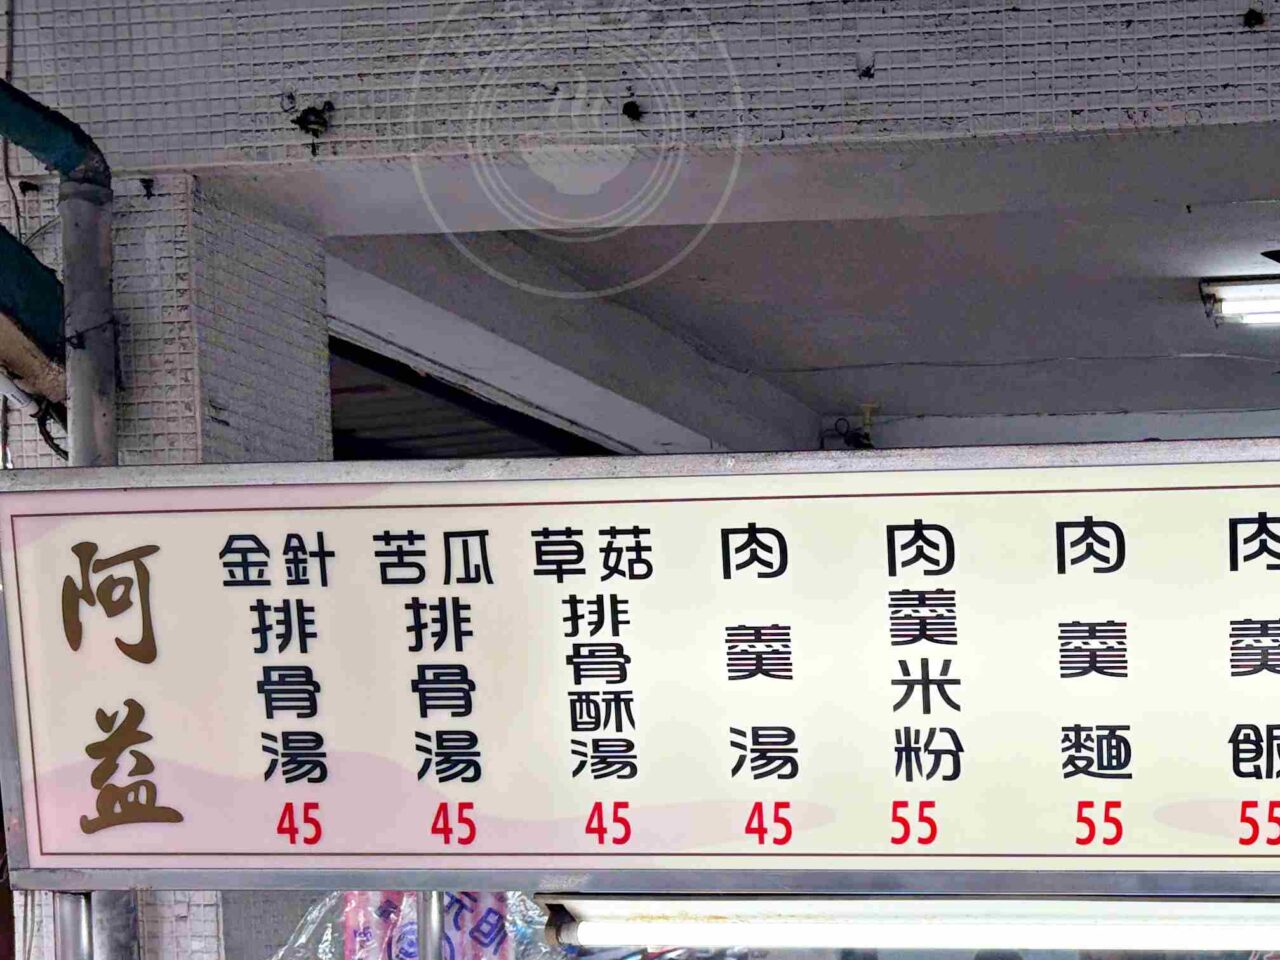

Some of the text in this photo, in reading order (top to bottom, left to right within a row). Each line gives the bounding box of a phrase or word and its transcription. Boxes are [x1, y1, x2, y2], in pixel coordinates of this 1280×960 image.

[62, 542, 186, 836] 阿益
[219, 532, 337, 785] 金針排骨湯
[373, 530, 495, 785] 苦瓜排骨湯
[531, 526, 655, 781] 草菇排骨酥湯
[721, 523, 800, 781] 肉羹湯
[887, 519, 966, 783] 肉羹米粉
[1056, 516, 1134, 781] 肉羹麵
[277, 802, 324, 847] 45
[431, 802, 478, 847] 45
[586, 802, 633, 846] 45
[745, 802, 794, 847] 45
[891, 801, 939, 846] 55
[1076, 801, 1124, 847] 55
